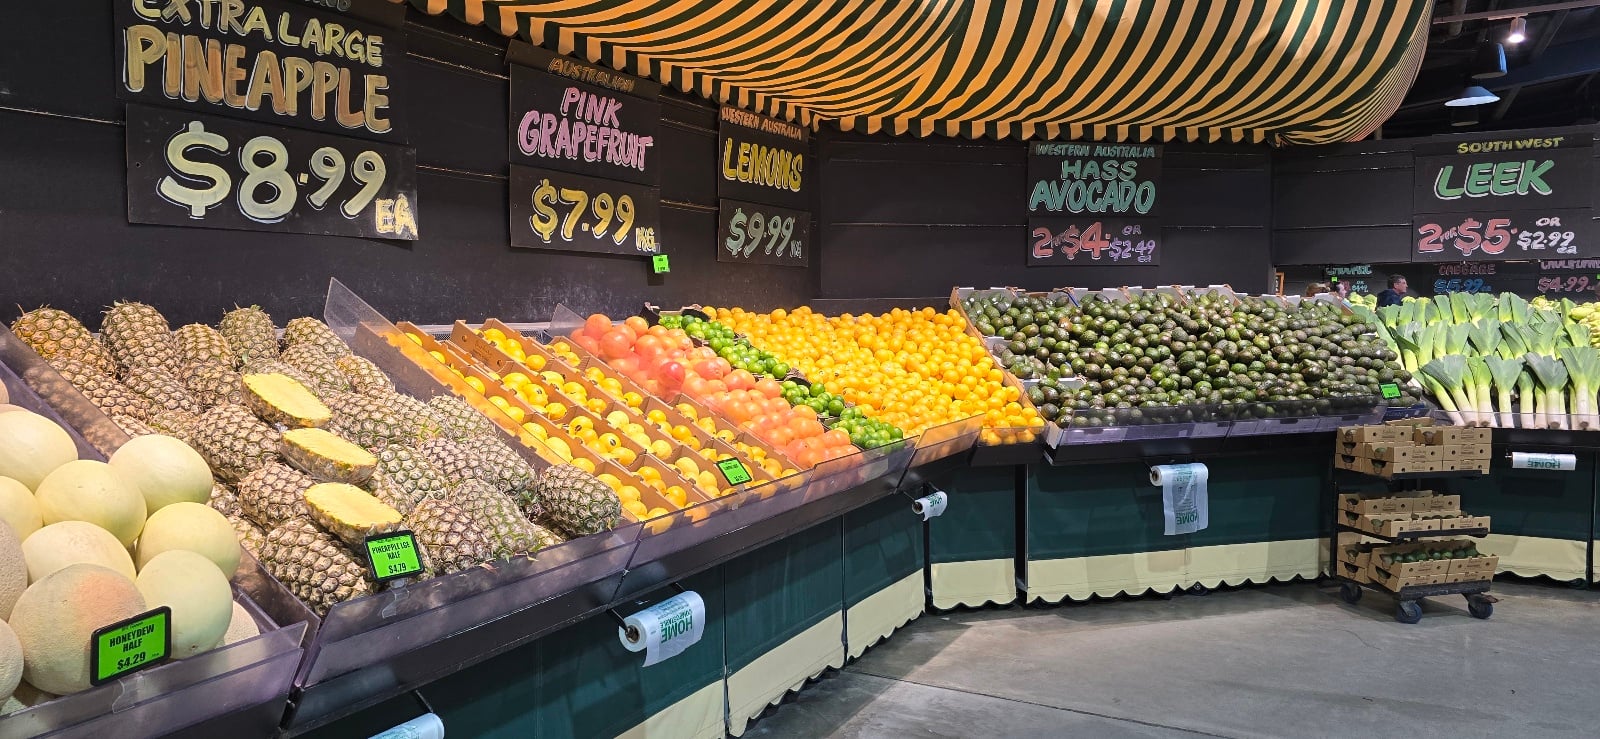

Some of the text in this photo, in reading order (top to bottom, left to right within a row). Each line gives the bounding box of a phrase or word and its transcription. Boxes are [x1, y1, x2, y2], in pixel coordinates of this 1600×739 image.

[132, 0, 384, 67] EXTRA LARGE
[123, 25, 392, 133] PINEAPPLE
[548, 58, 635, 92] AUSTRALIAN
[560, 87, 622, 128] PINK
[721, 107, 802, 140] WESTERN AUSTRALIA
[518, 110, 653, 171] GRAPEFRUIT
[1036, 144, 1156, 159] WESTERN AUSTRALIA
[1457, 136, 1564, 154] SOUTH WEST
[723, 138, 802, 192] LEMONS
[1061, 159, 1138, 181] HASS
[156, 121, 418, 240] $8.99 EA
[1434, 160, 1555, 200] LEEK
[1029, 180, 1156, 214] AVOCADO
[529, 179, 635, 245] $7.99
[1536, 217, 1561, 226] OR
[725, 207, 795, 258] $9.99
[1122, 225, 1141, 235] OR
[1517, 231, 1575, 250] $2.99
[1109, 237, 1155, 261] $2.49
[1439, 264, 1496, 275] CABBAGE
[1538, 276, 1589, 293] $4.99
[371, 542, 401, 554] PINEAPPLE
[388, 563, 407, 574] $4.79
[109, 624, 155, 647] HONEYDEW
[660, 616, 694, 643] HOME
[123, 638, 142, 652] HALF
[117, 652, 146, 670] $4.29
